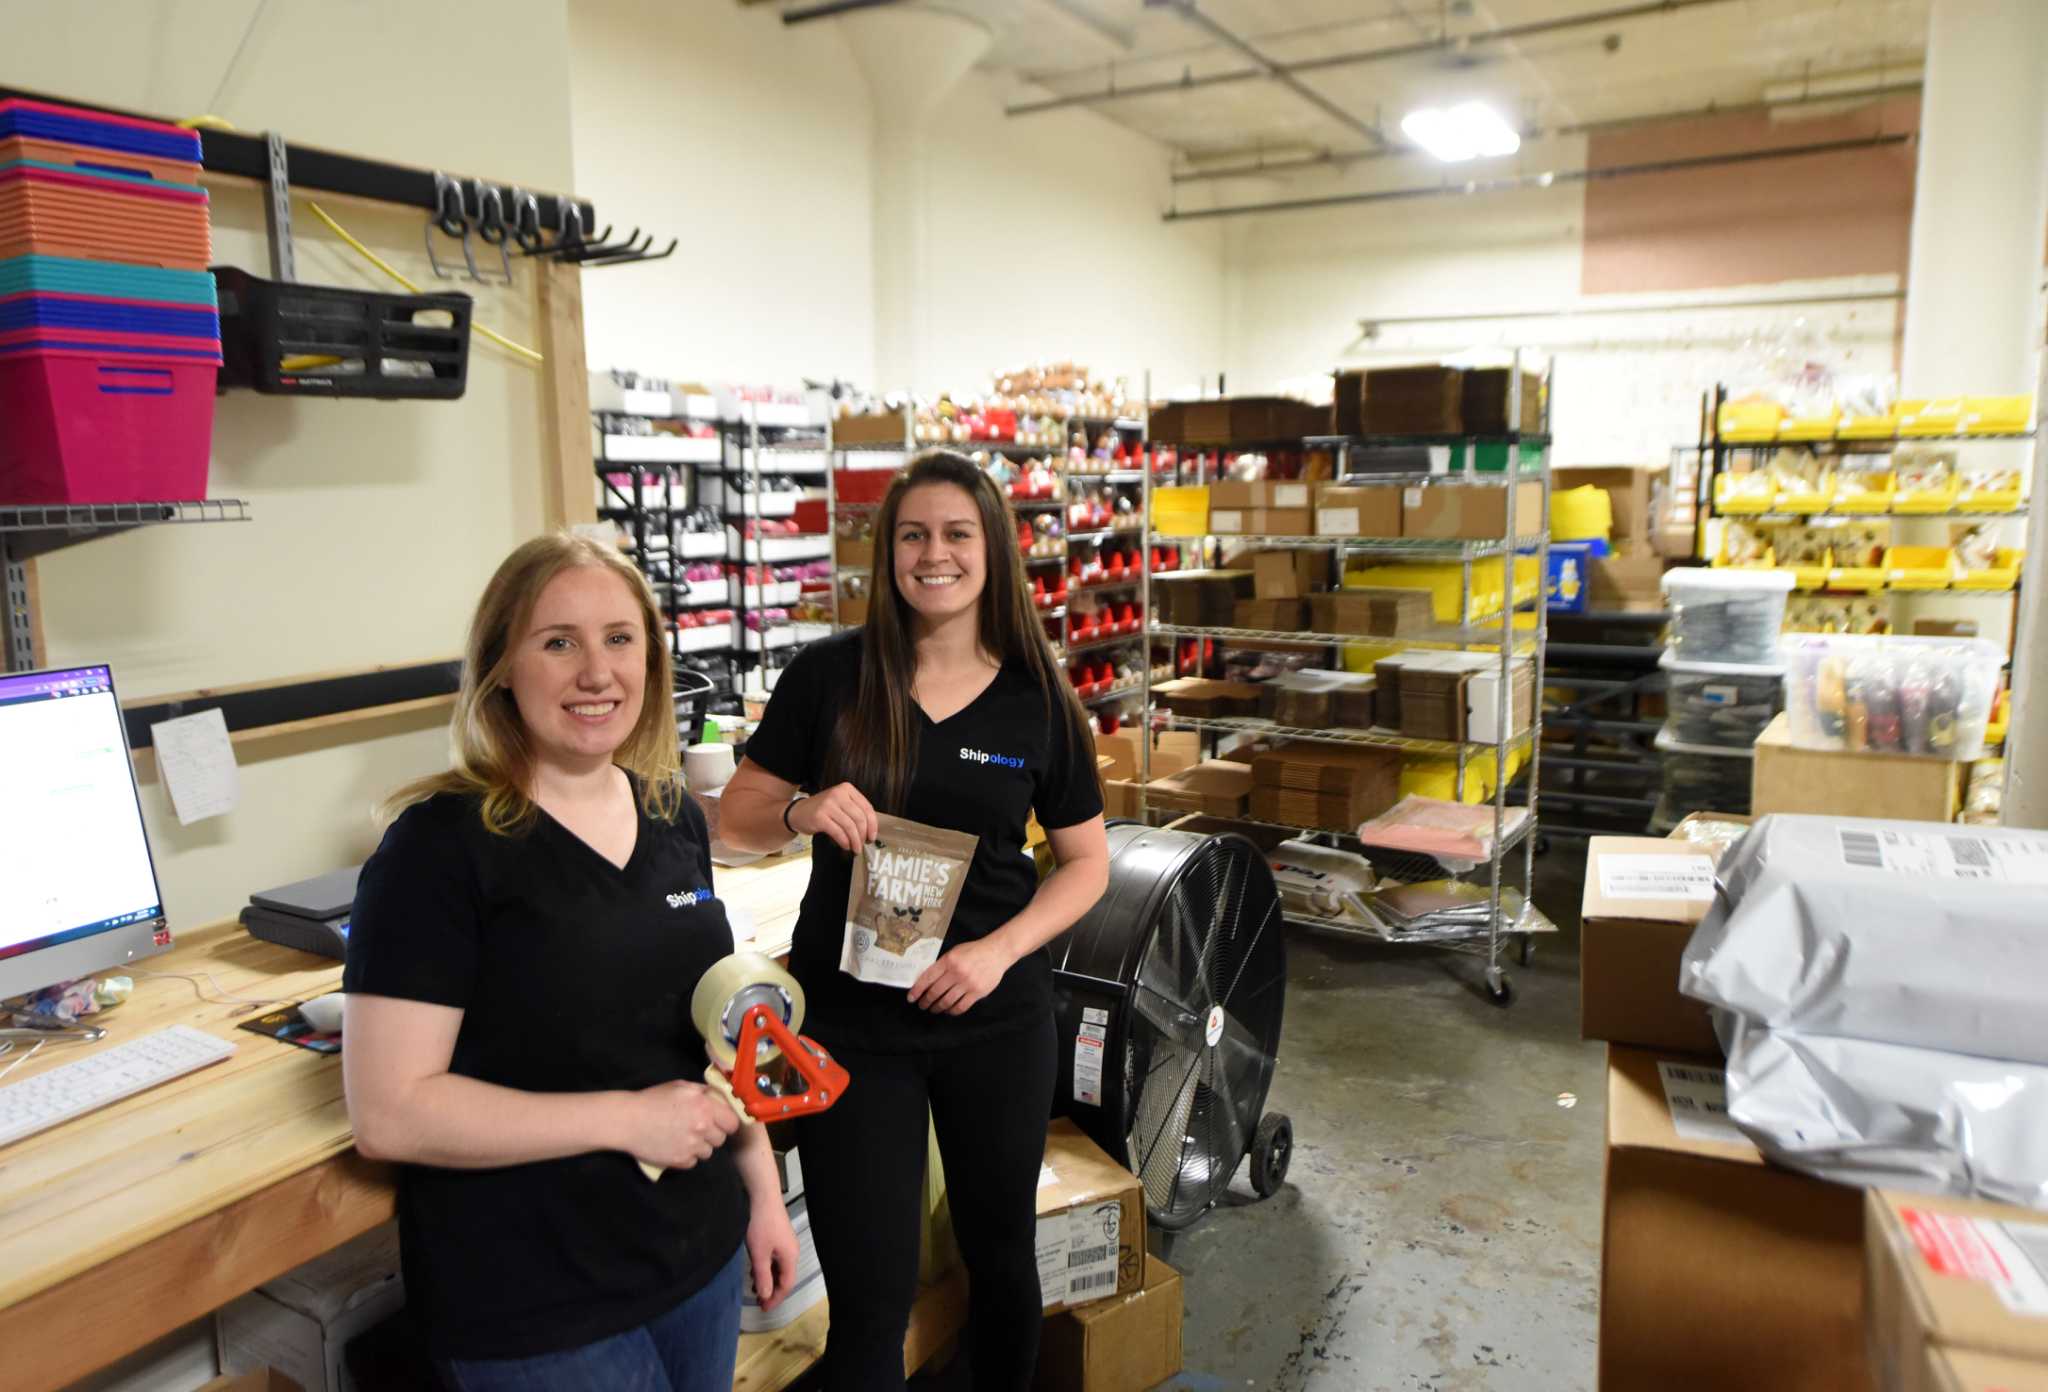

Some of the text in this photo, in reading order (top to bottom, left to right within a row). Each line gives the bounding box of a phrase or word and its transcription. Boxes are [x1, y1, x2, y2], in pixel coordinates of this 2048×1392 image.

[960, 748, 1025, 768] Shipology
[867, 849, 951, 886] JAMIE'S
[867, 872, 922, 906] FARM
[923, 884, 945, 898] NEW
